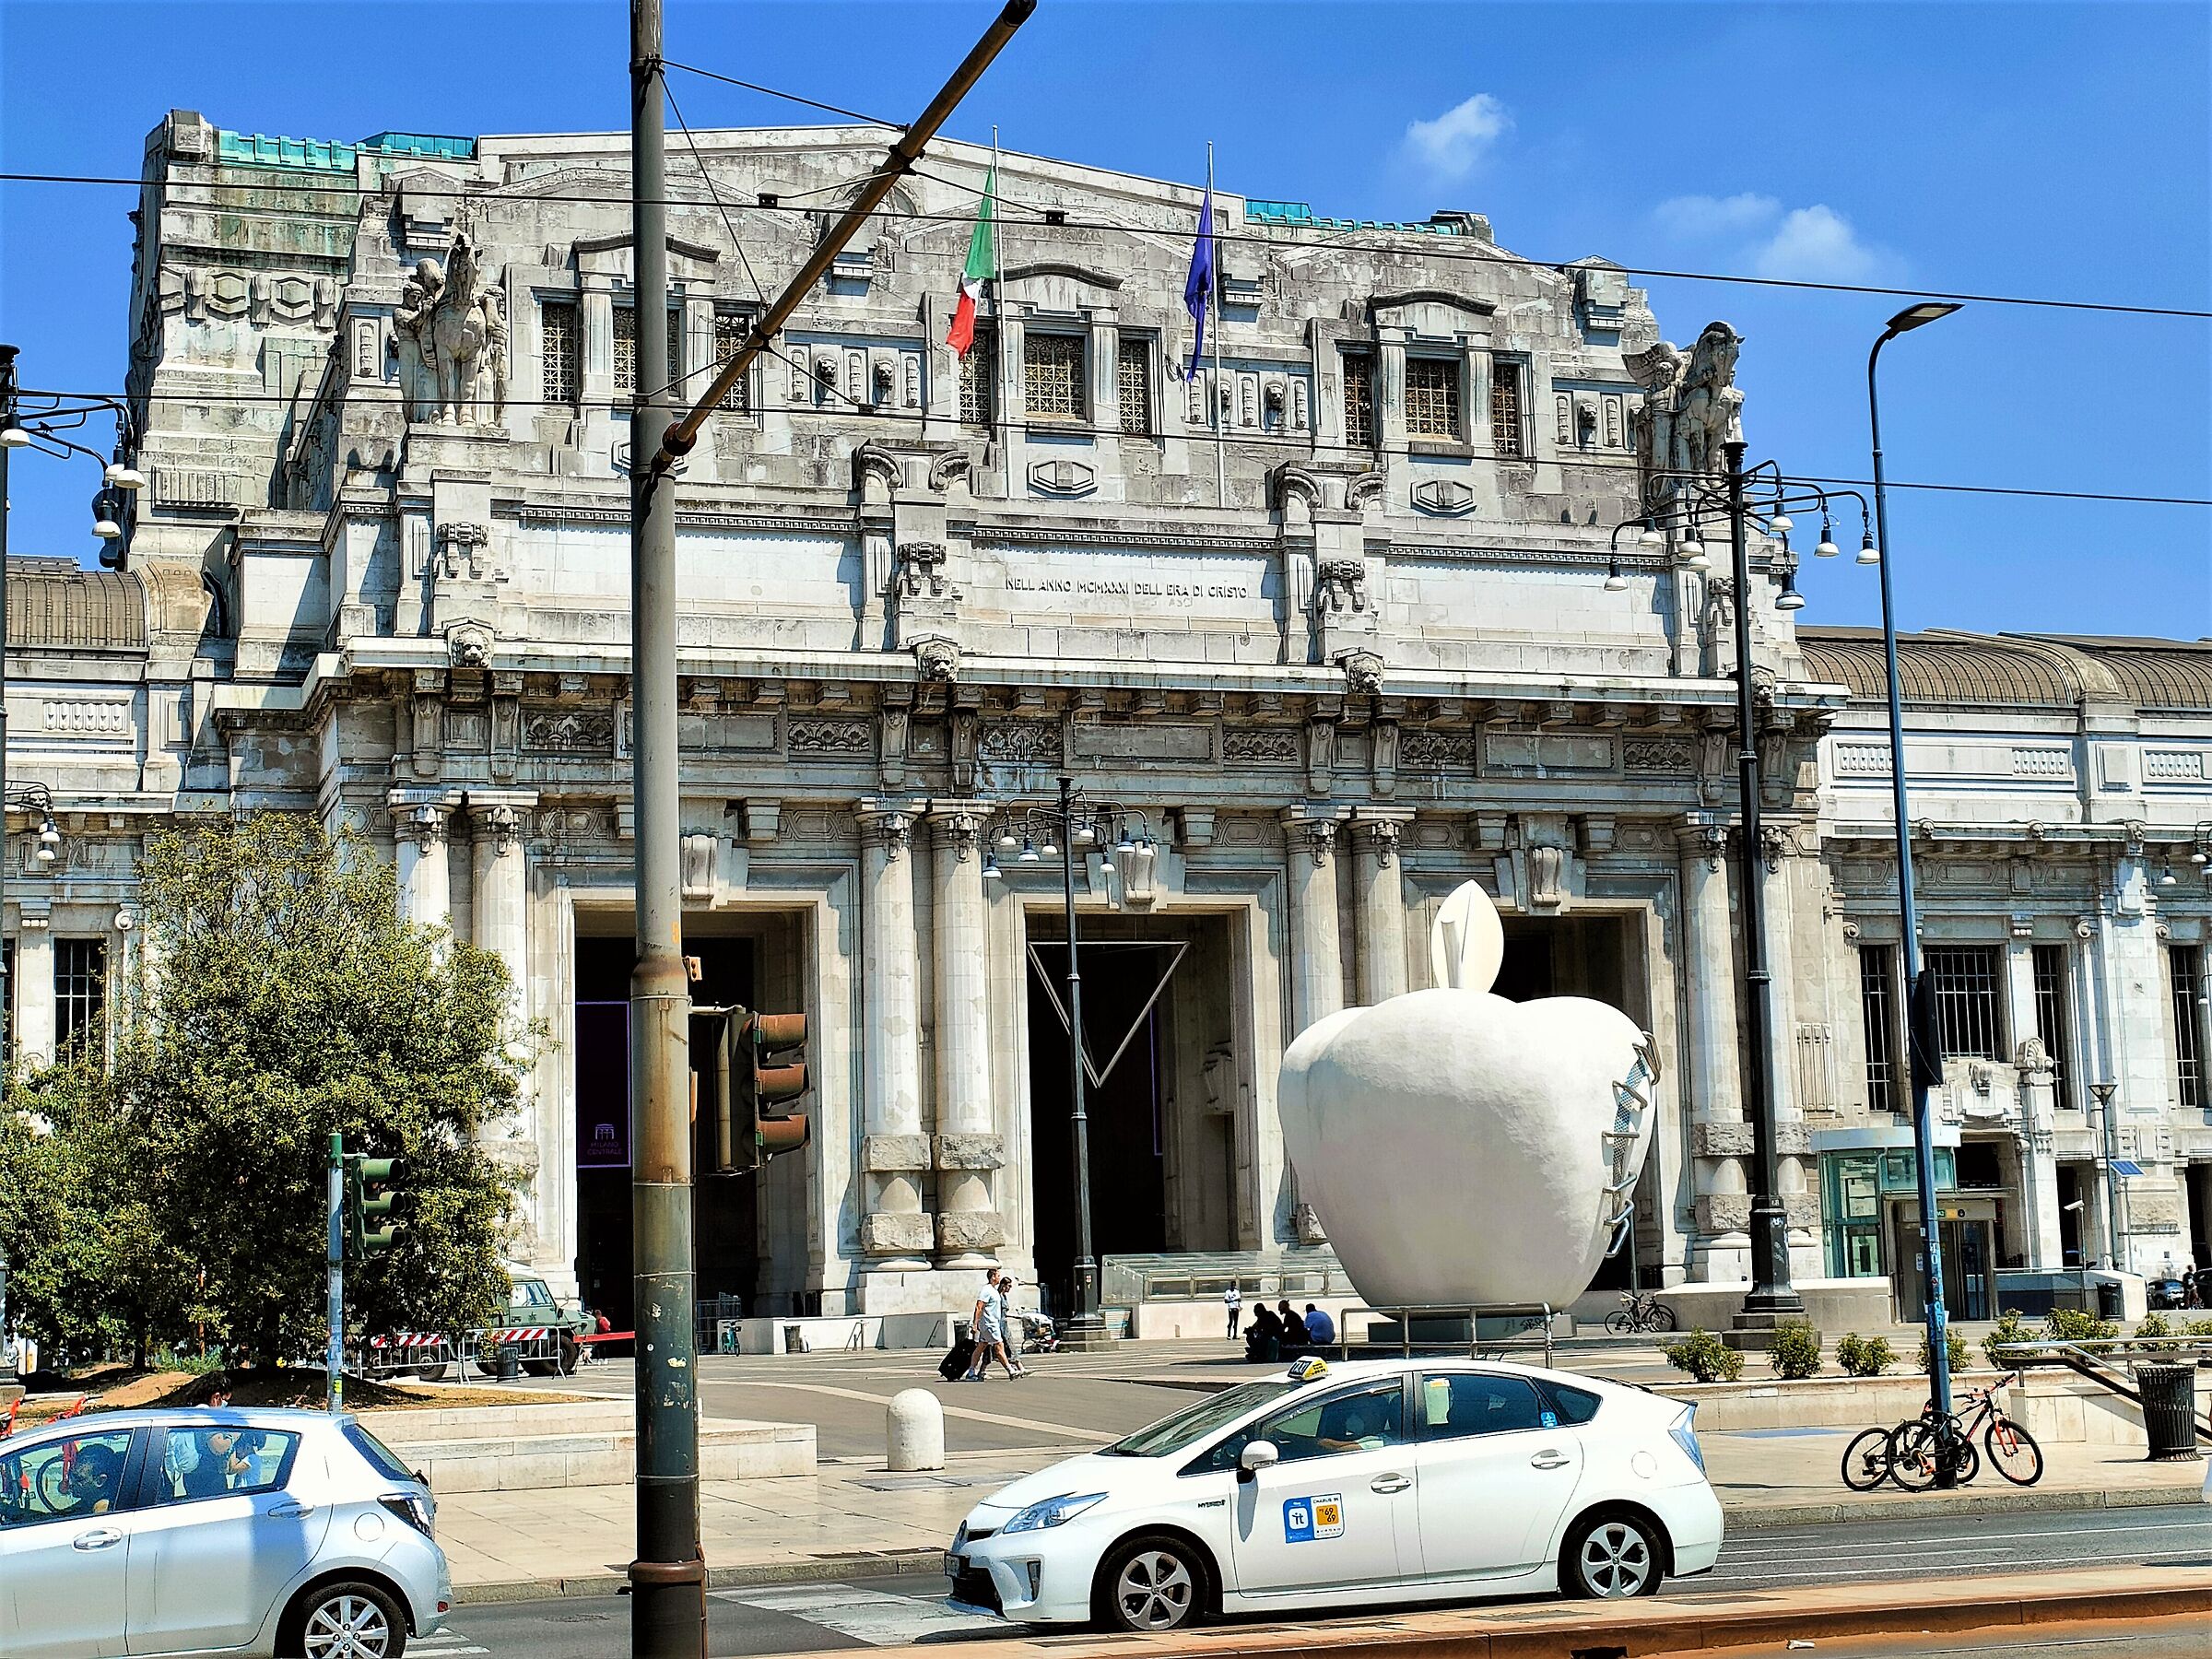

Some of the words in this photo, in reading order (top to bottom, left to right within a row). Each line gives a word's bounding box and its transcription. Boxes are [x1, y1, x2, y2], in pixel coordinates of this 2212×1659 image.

[1006, 577, 1035, 591] NELL
[1038, 578, 1072, 593] ANNO
[1077, 580, 1129, 594] MCMXXXI
[1135, 582, 1163, 596] DELL
[1166, 583, 1190, 597] ERA
[1193, 584, 1204, 598] DI
[1208, 585, 1247, 599] CRISTO
